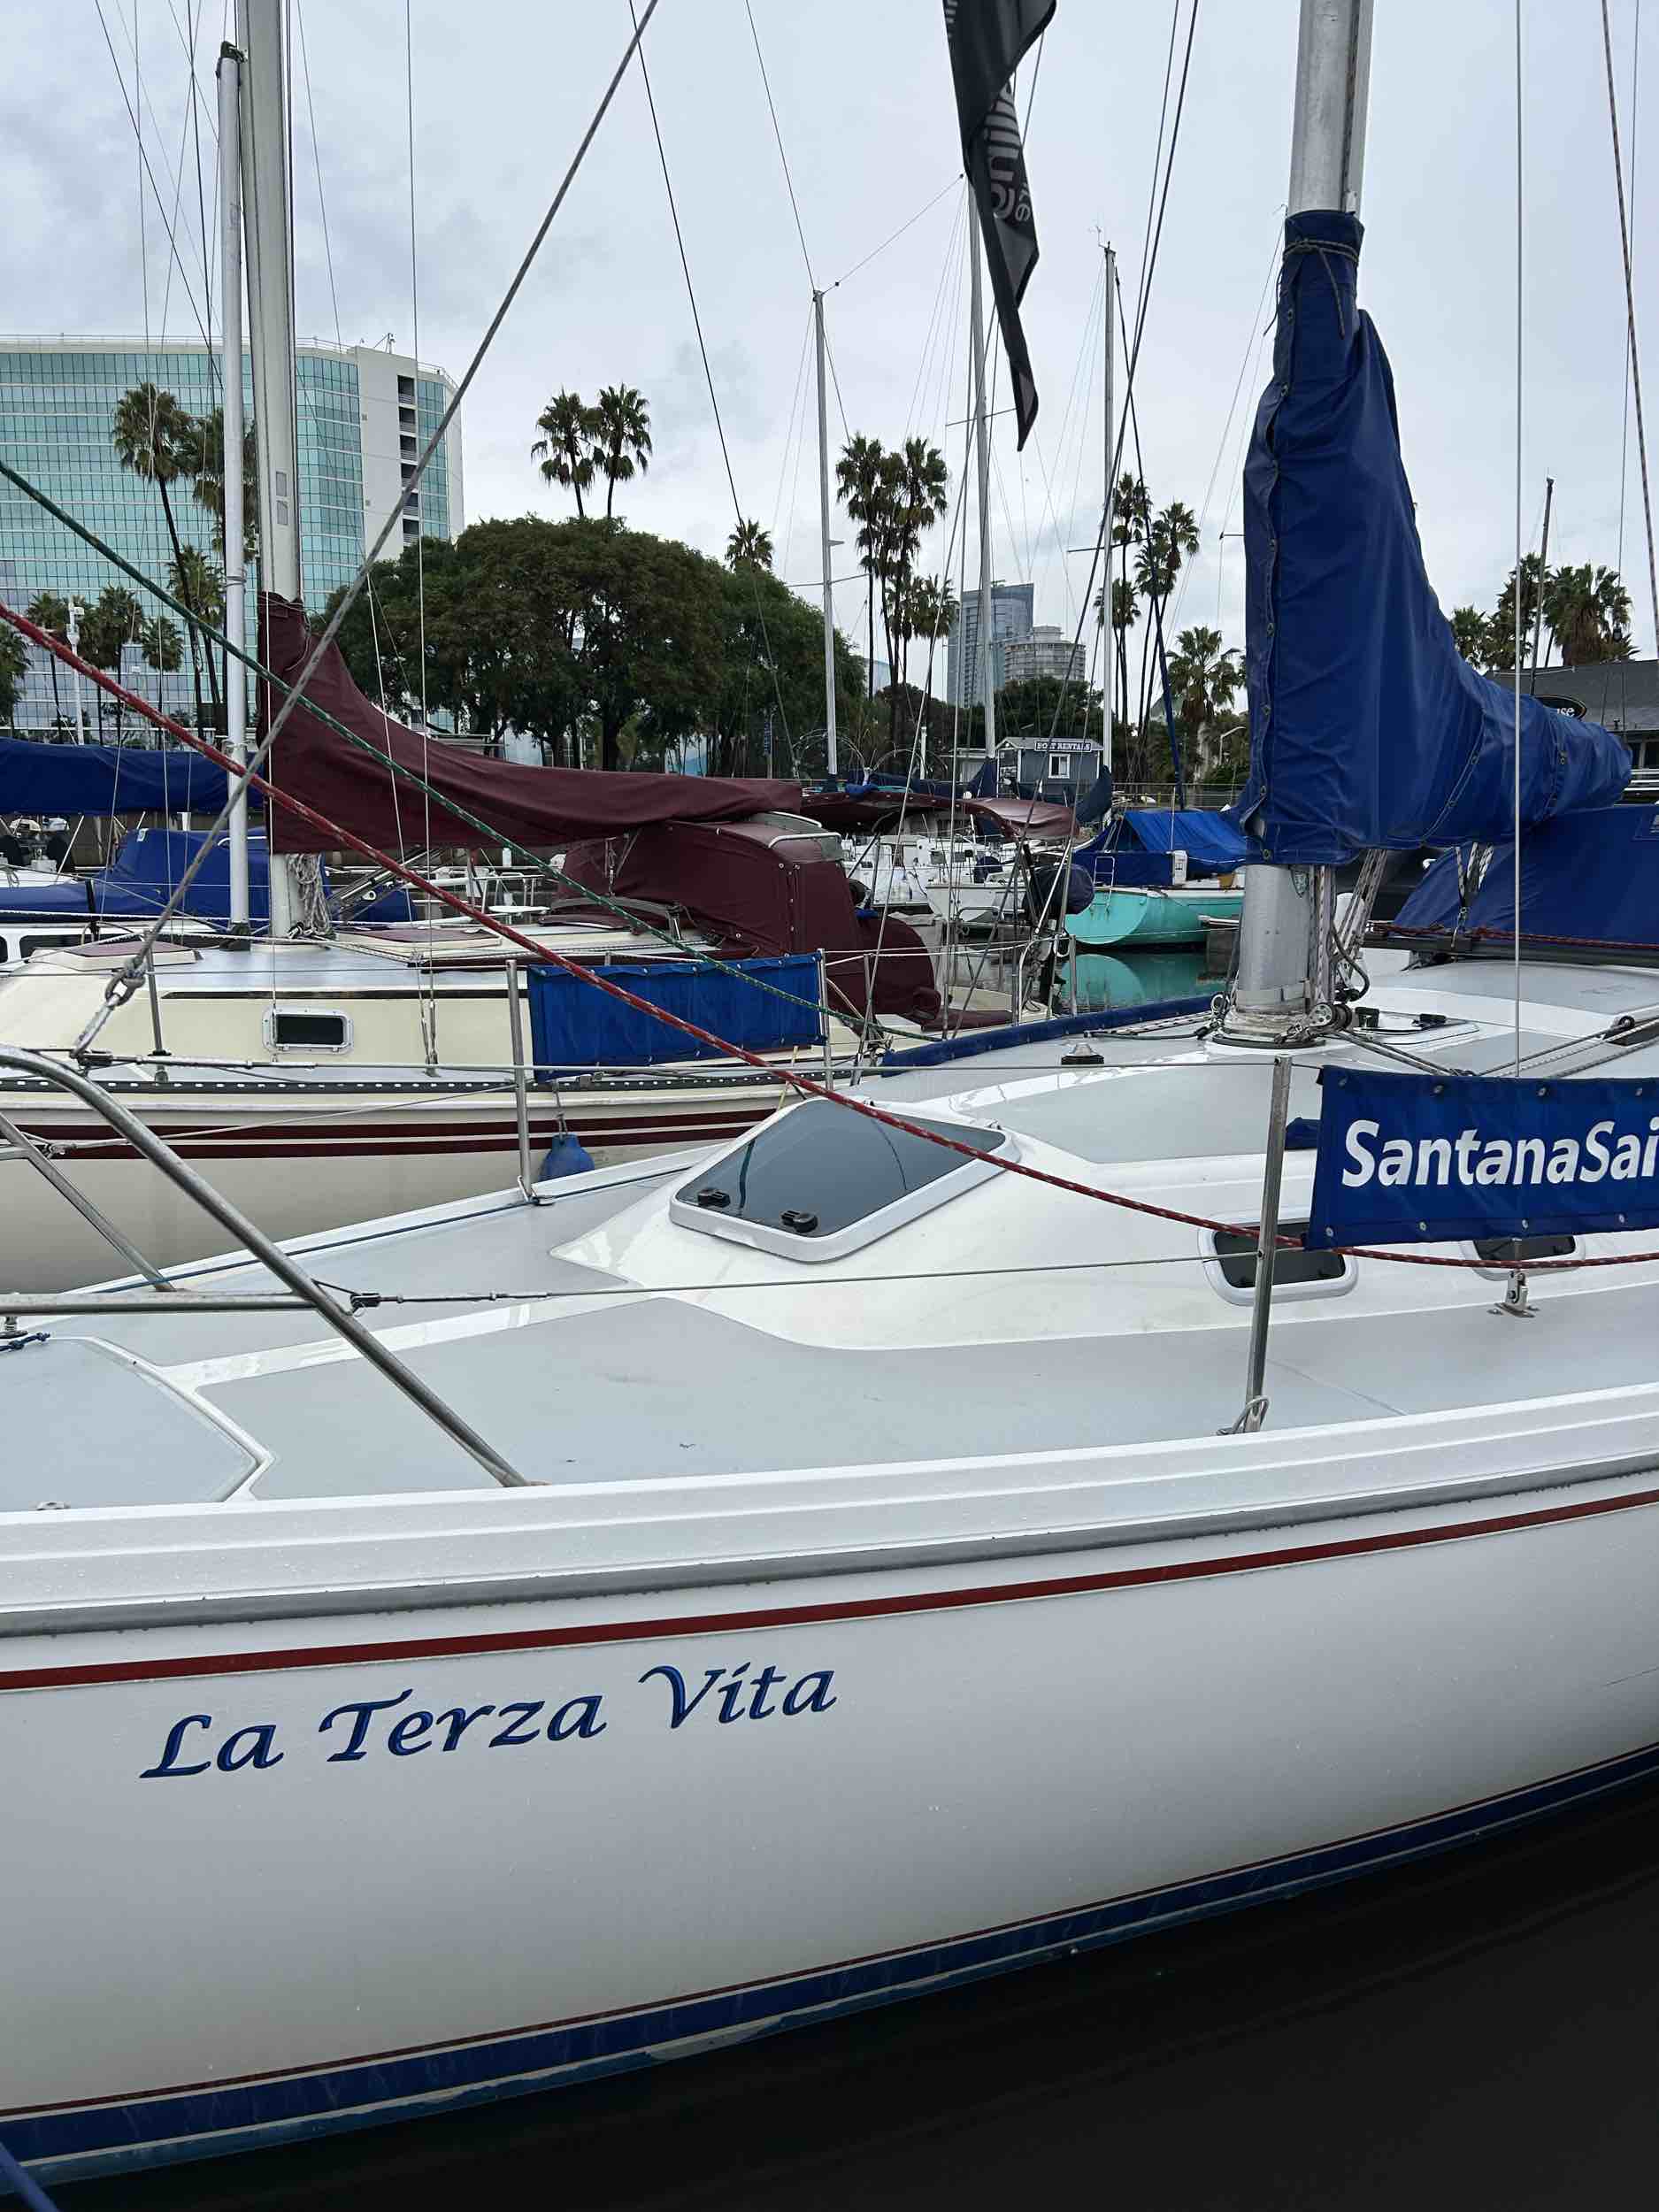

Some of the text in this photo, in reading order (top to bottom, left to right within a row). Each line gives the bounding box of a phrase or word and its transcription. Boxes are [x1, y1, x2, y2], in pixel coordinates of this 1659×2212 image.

[139, 1661, 838, 1779] La Terza Vita
